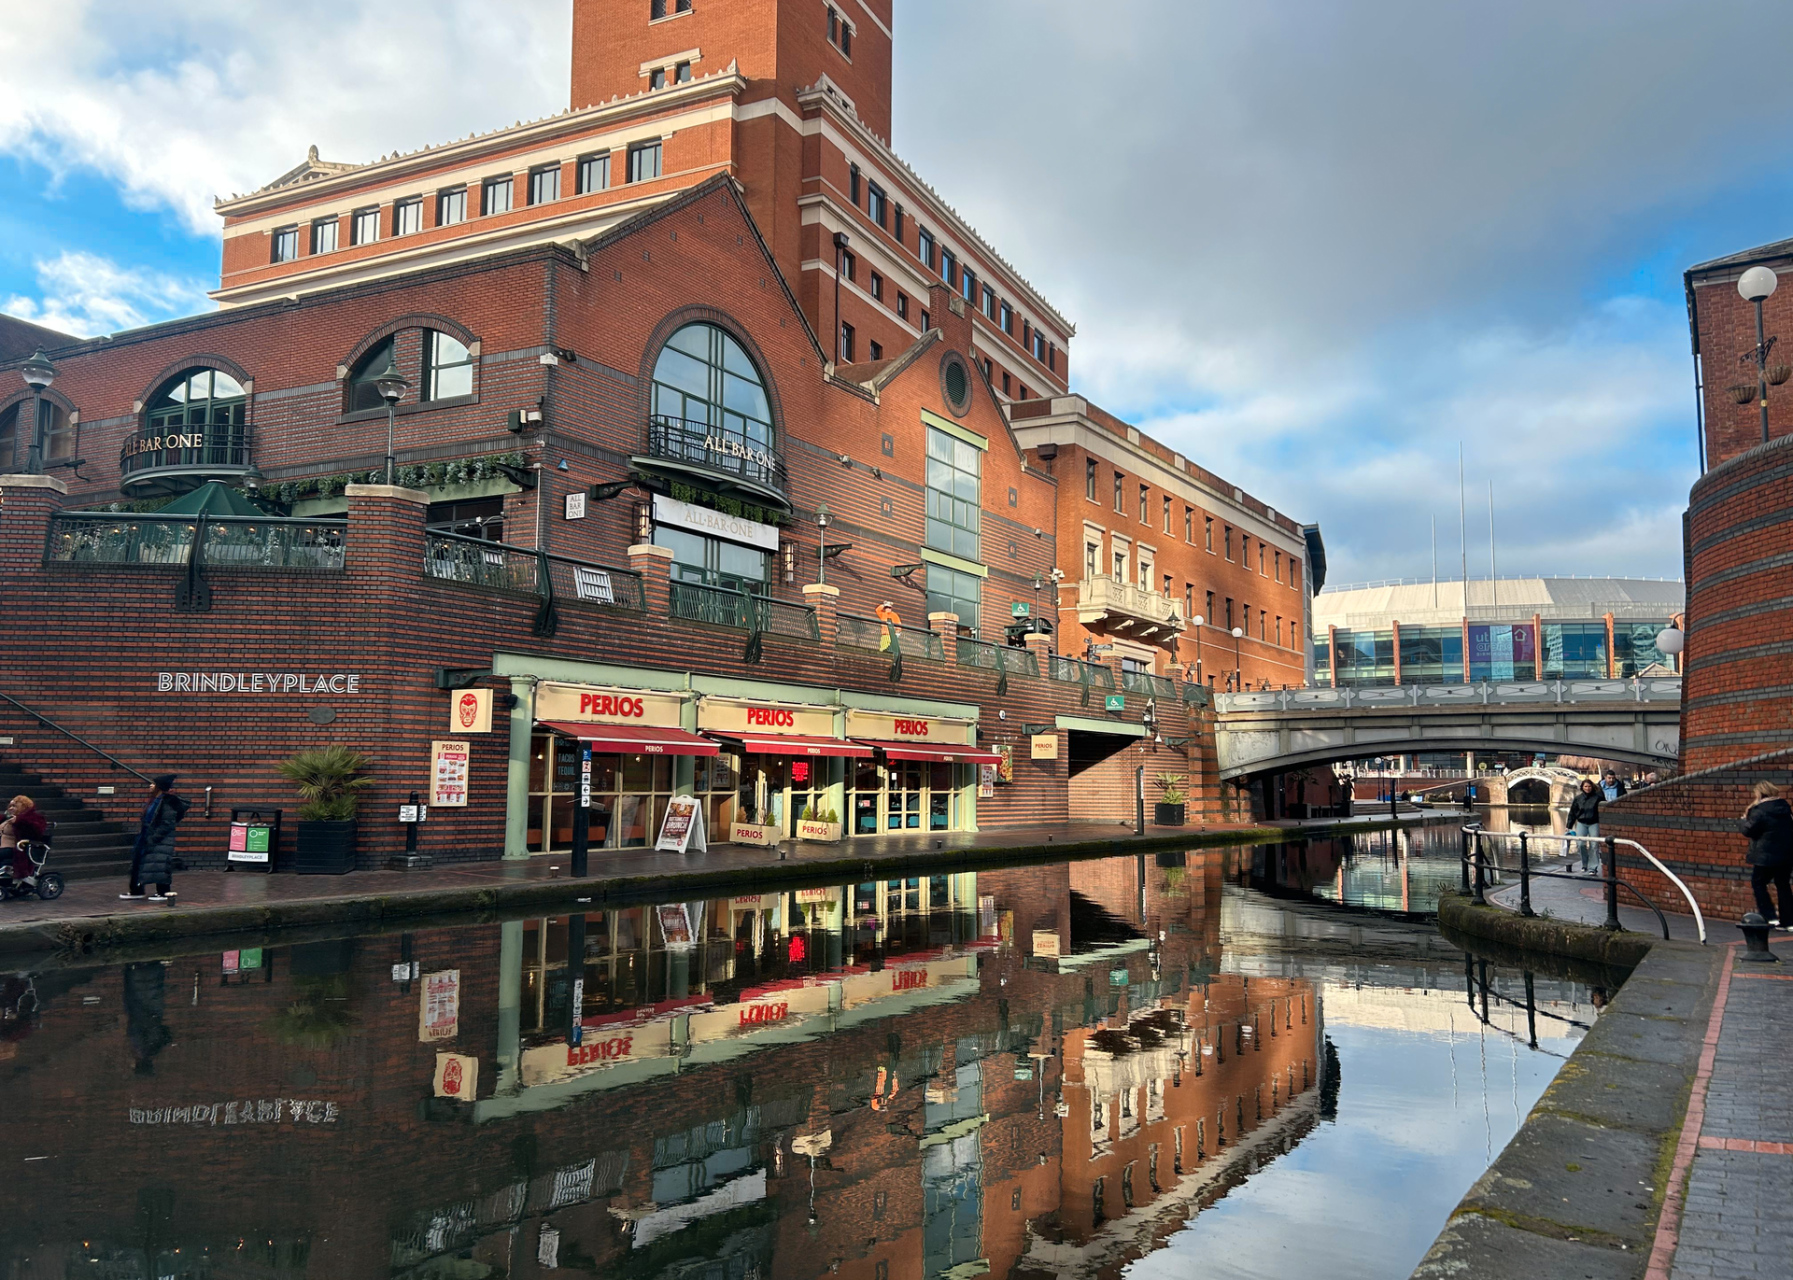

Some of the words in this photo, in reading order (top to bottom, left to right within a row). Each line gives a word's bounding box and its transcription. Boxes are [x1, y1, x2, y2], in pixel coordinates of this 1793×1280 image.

[139, 436, 162, 453] BAR
[166, 433, 203, 449] ONE
[703, 434, 728, 454] ALL
[731, 442, 754, 462] BAR
[756, 451, 776, 472] ONE
[569, 494, 582, 502] ALL
[569, 502, 582, 510] BAR
[568, 509, 583, 518] ONE
[157, 672, 360, 694] BRINDLEYPLACE
[580, 693, 644, 717] PERIOS
[747, 707, 794, 727] PERIOS
[894, 719, 928, 736] PERIOS
[441, 743, 464, 751] PERIOS
[644, 745, 664, 753] PERIOS
[557, 753, 576, 763] TACOS
[736, 828, 763, 840] PERIOS
[802, 825, 828, 836] PERIOS
